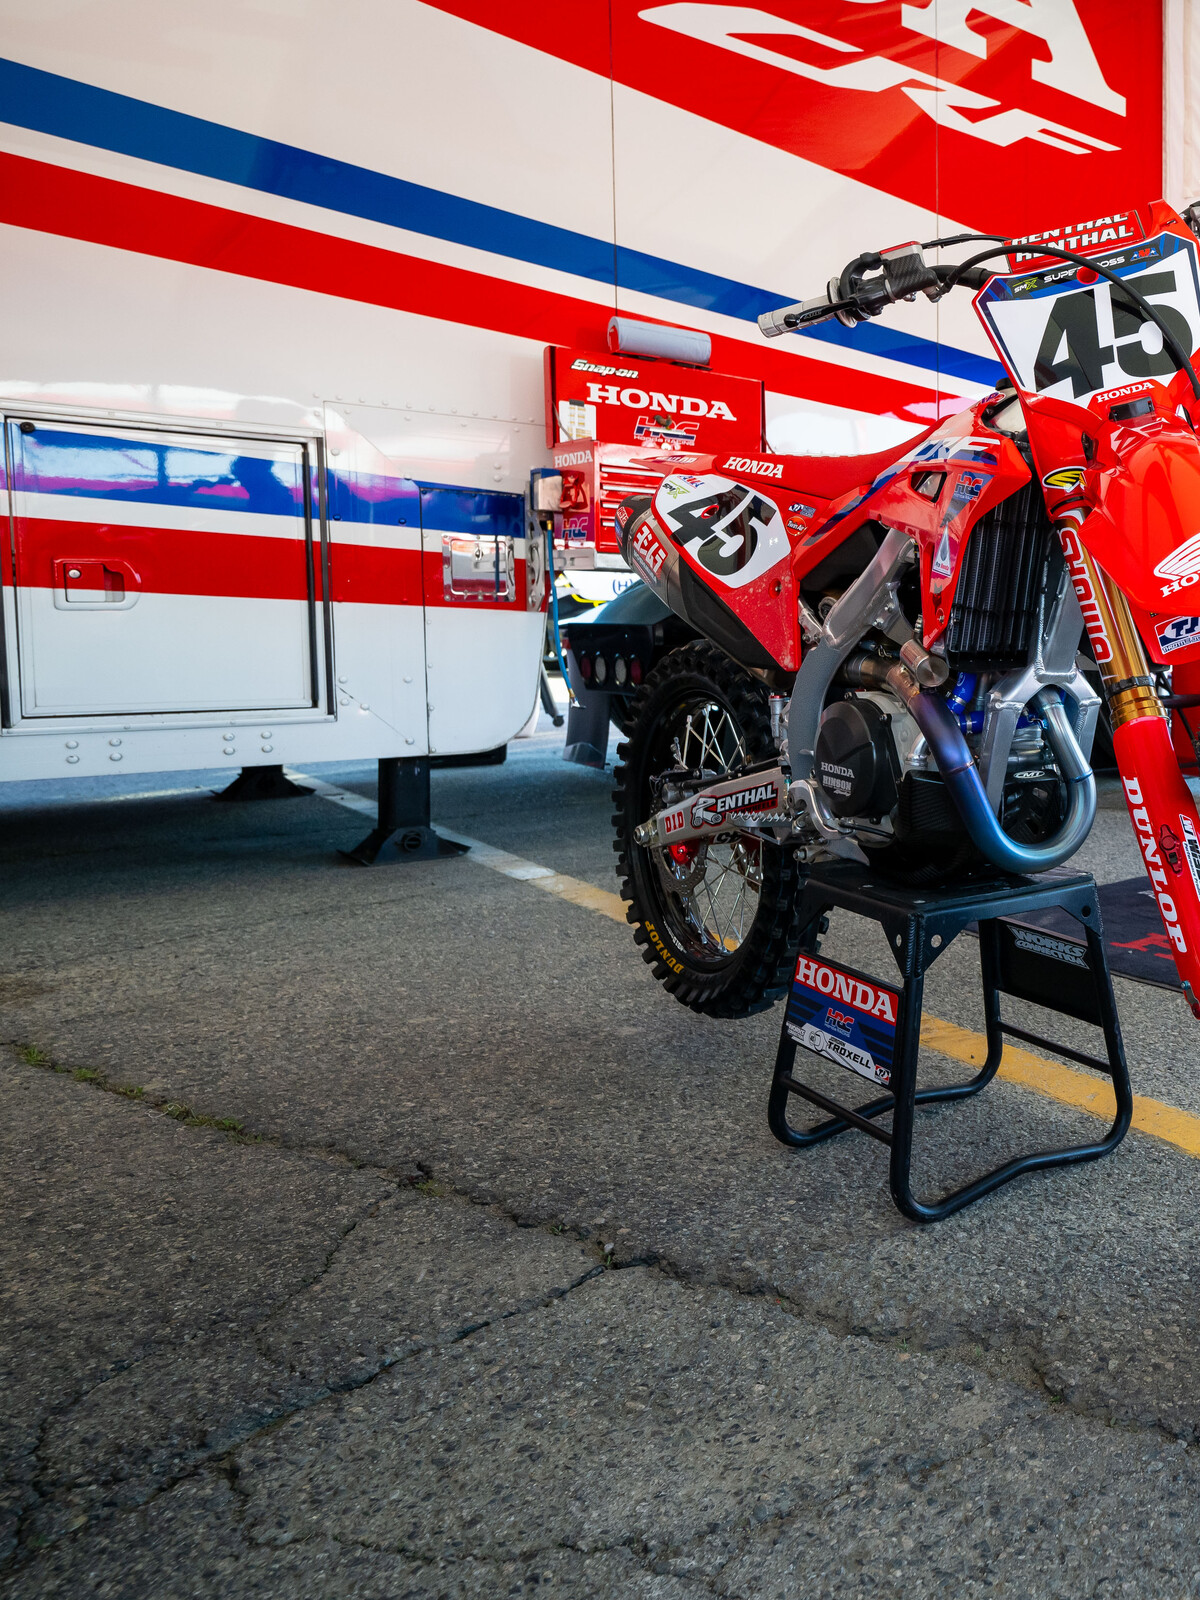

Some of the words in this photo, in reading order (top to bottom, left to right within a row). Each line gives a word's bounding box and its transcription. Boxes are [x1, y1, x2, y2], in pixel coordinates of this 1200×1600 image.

[1130, 247, 1160, 261] AMA
[1043, 255, 1126, 283] SUPEOSS
[1034, 270, 1193, 399] 45
[571, 358, 639, 379] Snap-on
[586, 382, 737, 421] HONDA
[1095, 381, 1155, 404] HONDA
[634, 415, 700, 441] HRC
[554, 450, 593, 468] HONDA
[722, 456, 784, 478] HONDA
[562, 517, 588, 539] HRC
[666, 484, 777, 576] 45
[1057, 527, 1114, 664] SHOWA
[1171, 616, 1199, 638] TJ
[821, 761, 855, 779] HONDA
[822, 774, 852, 790] HINSON
[692, 784, 777, 828] RENTHAL
[664, 810, 685, 834] DID
[1123, 776, 1188, 953] DUNLOP
[645, 920, 684, 974] DUNLOP
[1008, 926, 1085, 957] WORKS
[1015, 940, 1087, 967] CONNECTION
[796, 957, 896, 1023] HONDA
[824, 1007, 855, 1033] HRC
[827, 1040, 872, 1070] TROXELL
